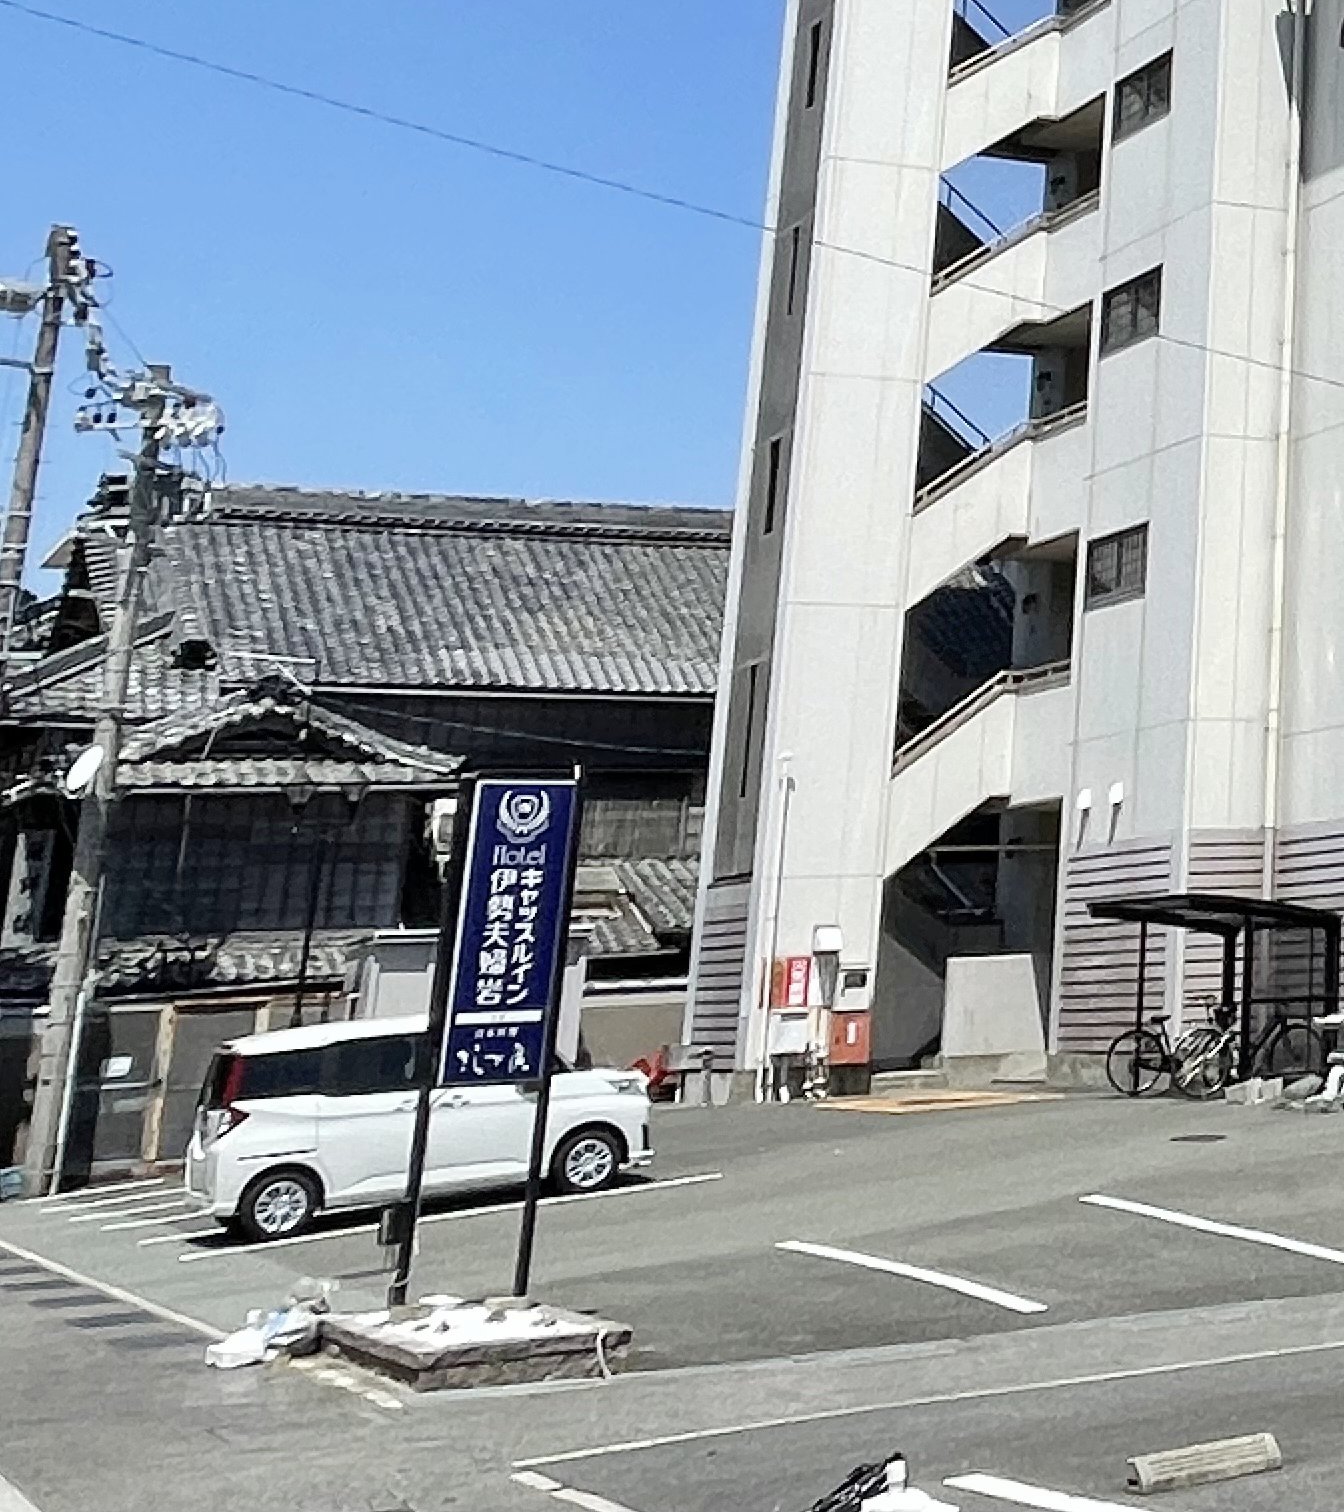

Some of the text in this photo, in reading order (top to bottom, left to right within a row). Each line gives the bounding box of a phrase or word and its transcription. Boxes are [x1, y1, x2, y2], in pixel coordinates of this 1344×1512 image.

[492, 843, 547, 866] Hotel
[505, 867, 544, 1006] キャッスルイン
